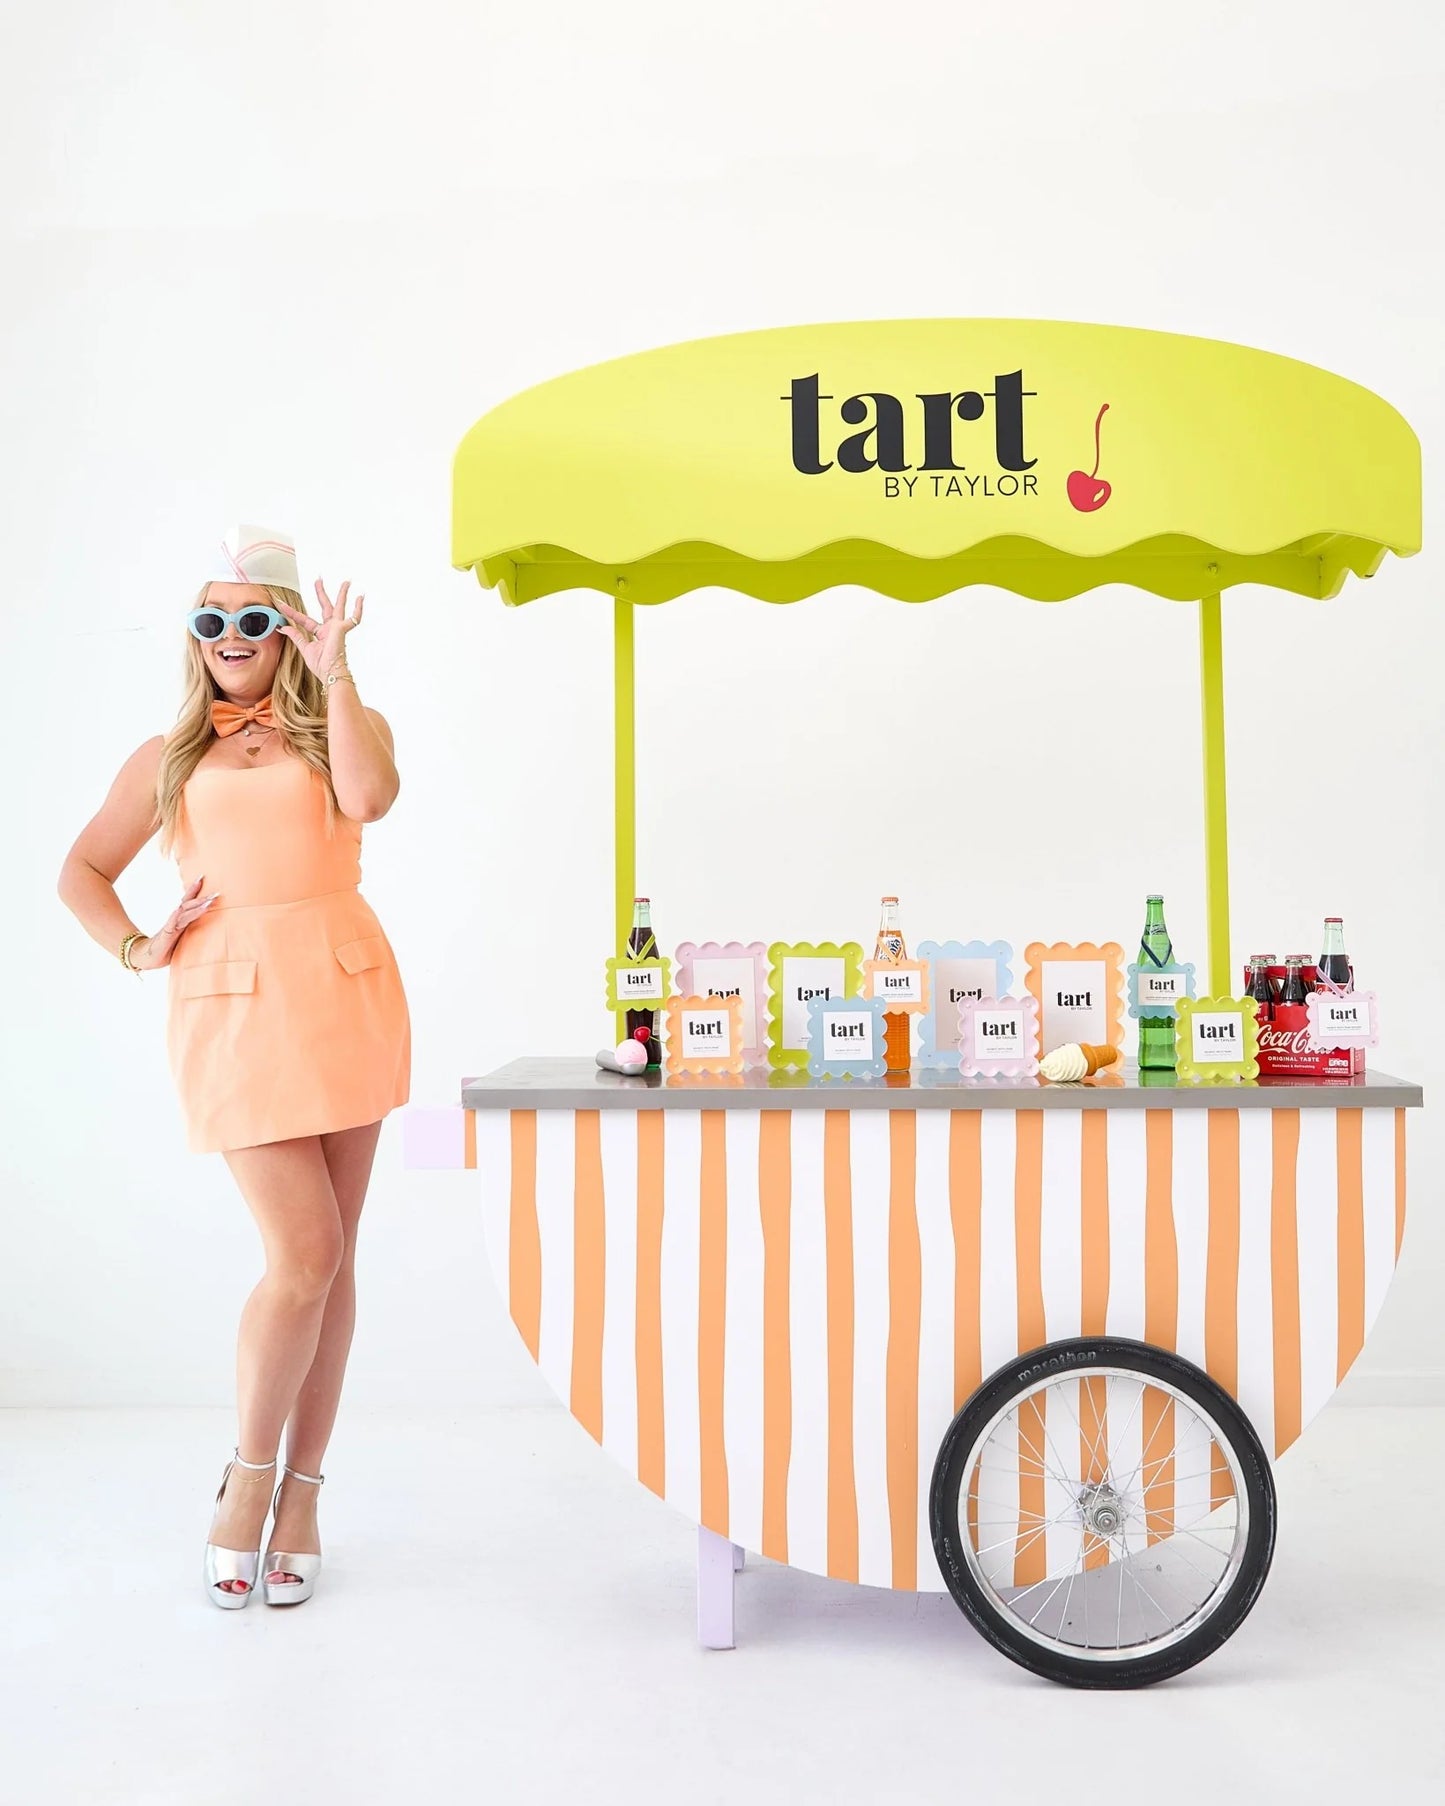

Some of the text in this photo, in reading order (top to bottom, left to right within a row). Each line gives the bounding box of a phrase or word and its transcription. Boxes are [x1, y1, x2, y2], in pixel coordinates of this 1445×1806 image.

[780, 369, 1038, 475] tart
[884, 474, 1039, 498] BY TAYLOR
[627, 973, 652, 985] tart
[884, 976, 910, 988] tart
[1149, 979, 1175, 991] tart
[1057, 991, 1092, 1007] tart
[1330, 1008, 1357, 1020] tart
[689, 1020, 722, 1036] tart
[830, 1022, 865, 1038] tart
[982, 1020, 1017, 1036] tart
[1199, 1023, 1235, 1039] tart
[1017, 1350, 1098, 1382] marathon
